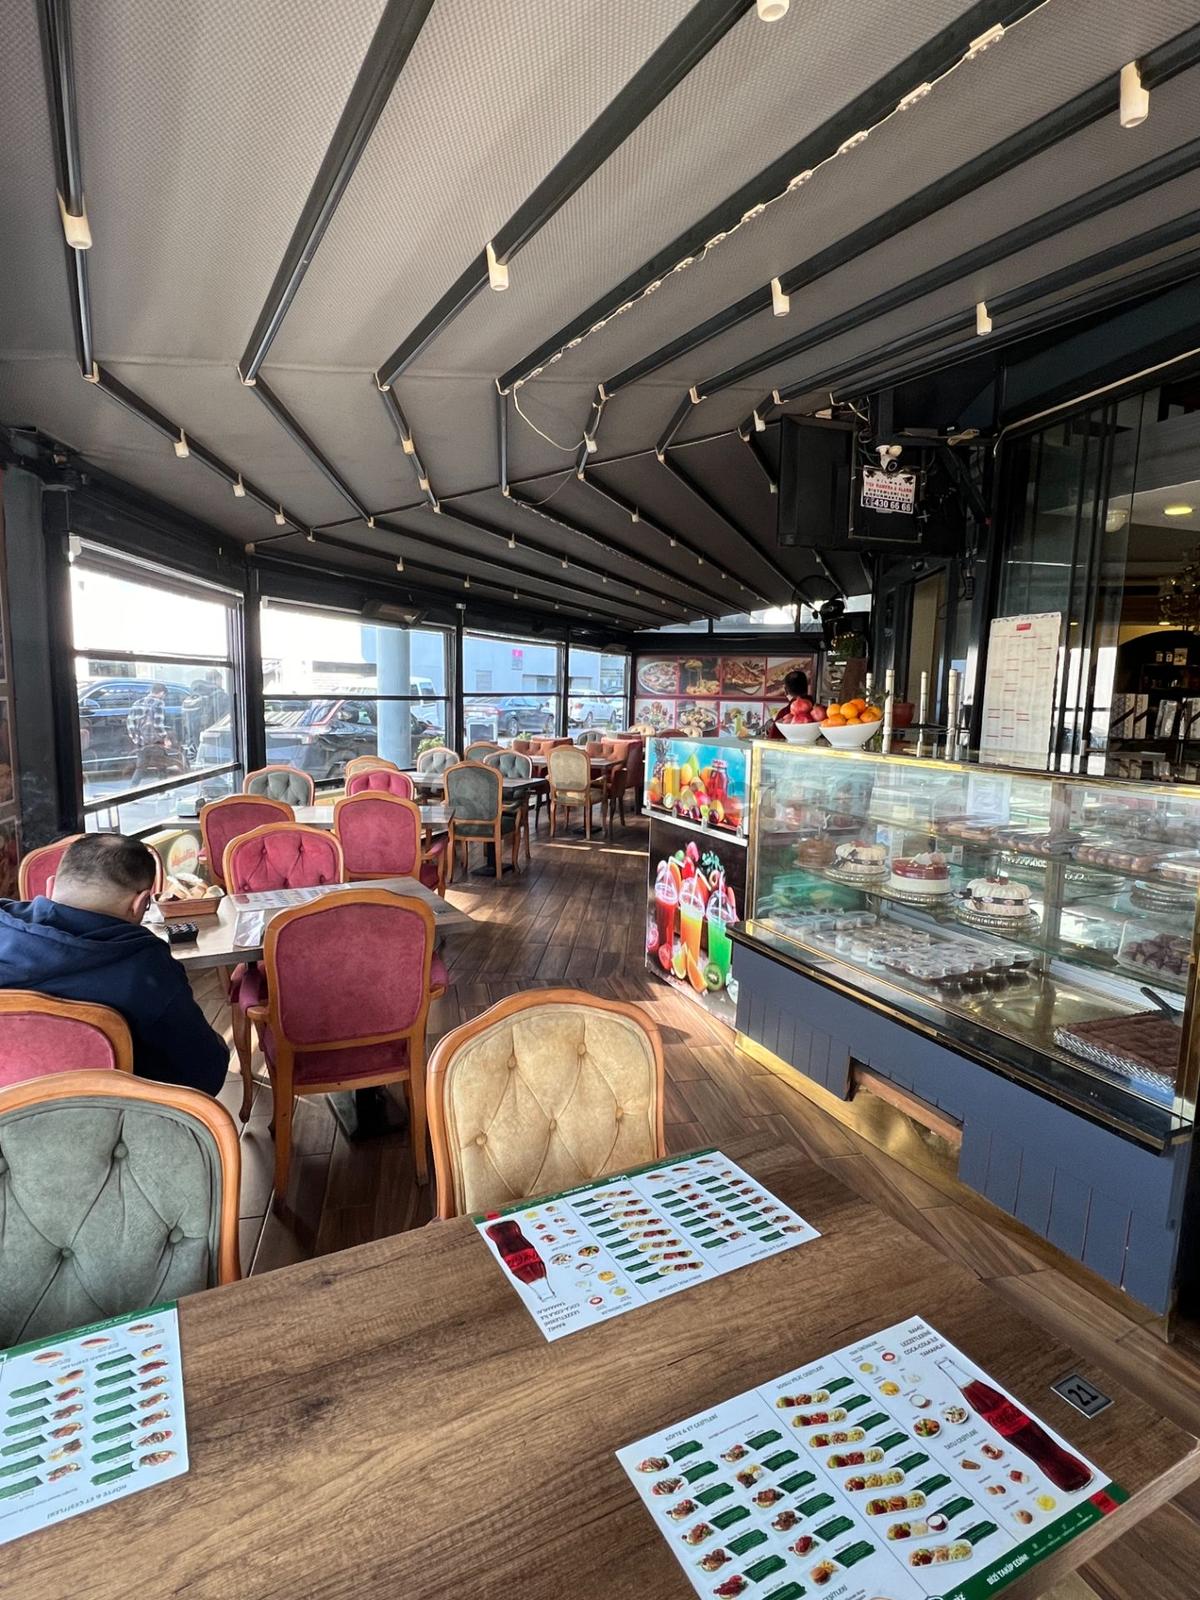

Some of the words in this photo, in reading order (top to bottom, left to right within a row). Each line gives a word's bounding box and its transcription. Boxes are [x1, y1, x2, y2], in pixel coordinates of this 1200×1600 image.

[874, 499, 889, 508] 430
[890, 501, 900, 510] 66
[1067, 1384, 1099, 1407] 21
[997, 1563, 1014, 1578] TAKİP
